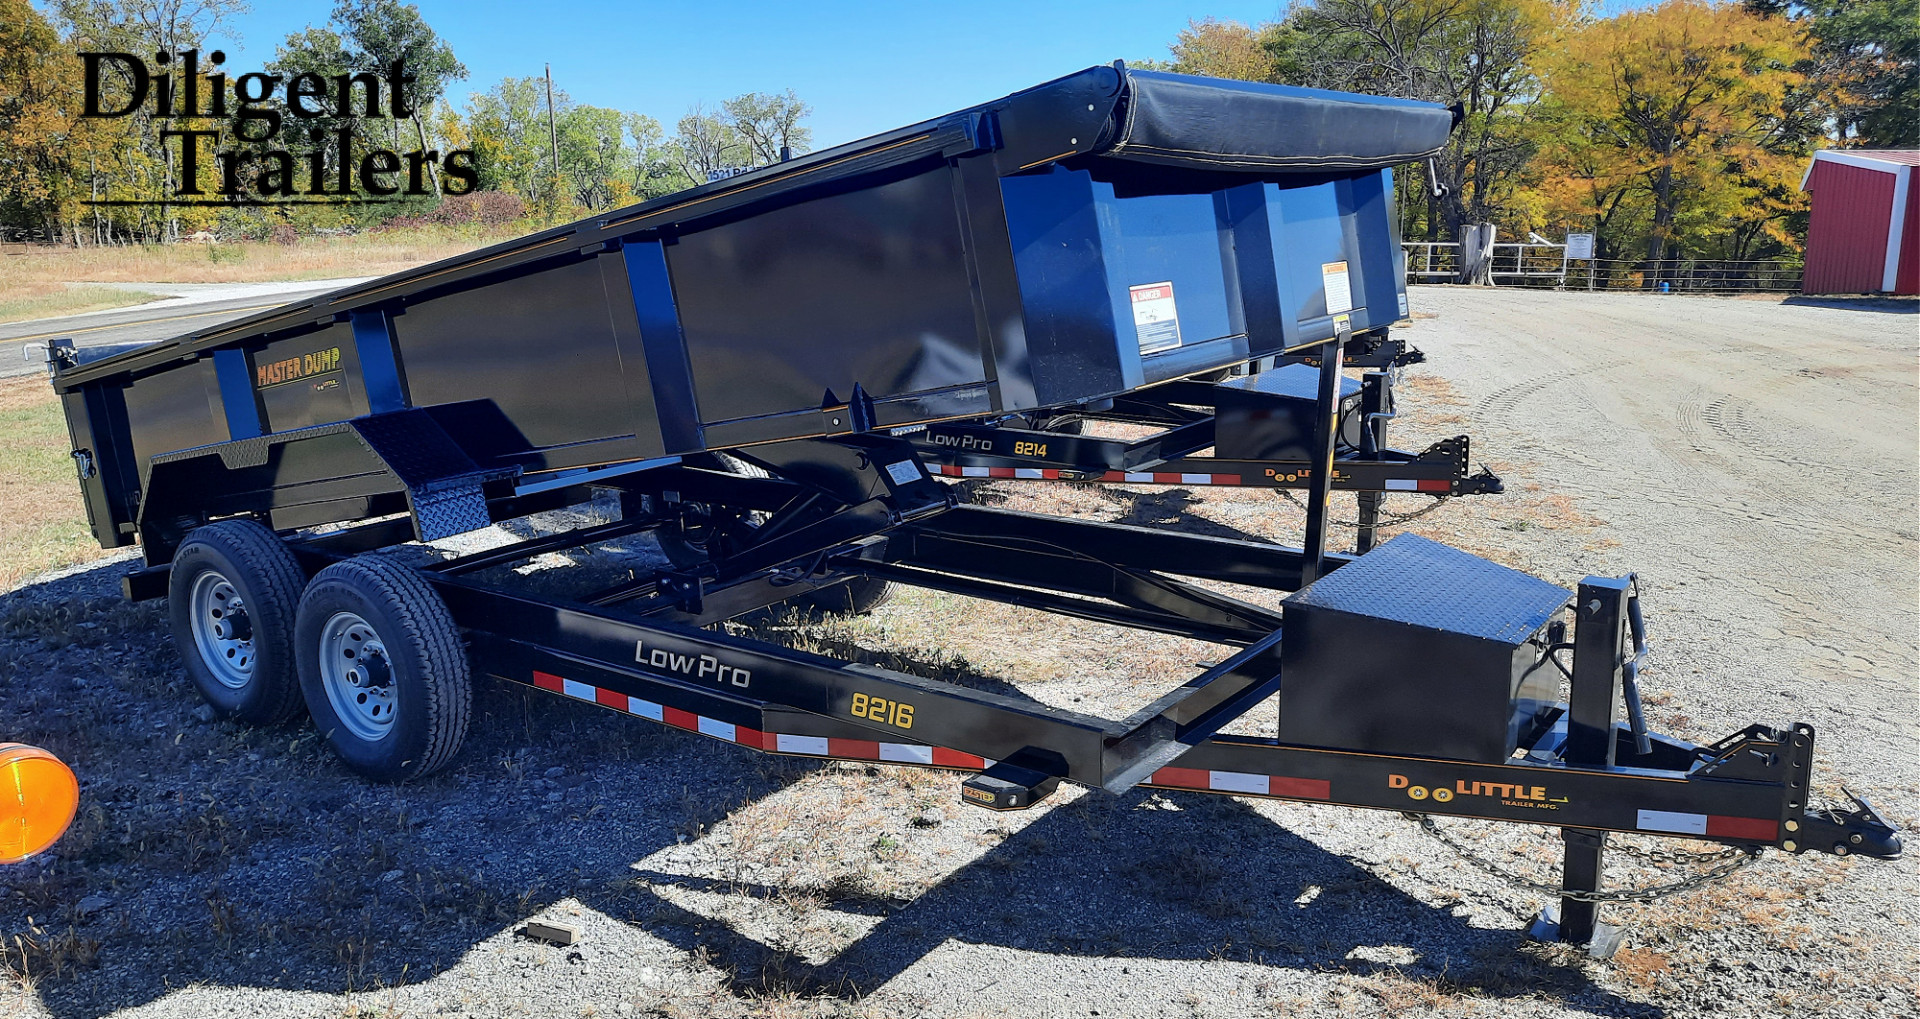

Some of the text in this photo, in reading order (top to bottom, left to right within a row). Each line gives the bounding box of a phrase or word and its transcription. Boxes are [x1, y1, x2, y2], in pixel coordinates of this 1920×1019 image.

[707, 169, 731, 180] 1521
[257, 347, 340, 387] MASTER DUMP
[1014, 441, 1047, 457] 8214
[851, 692, 915, 729] 8216
[1501, 800, 1534, 808] TRAILER
